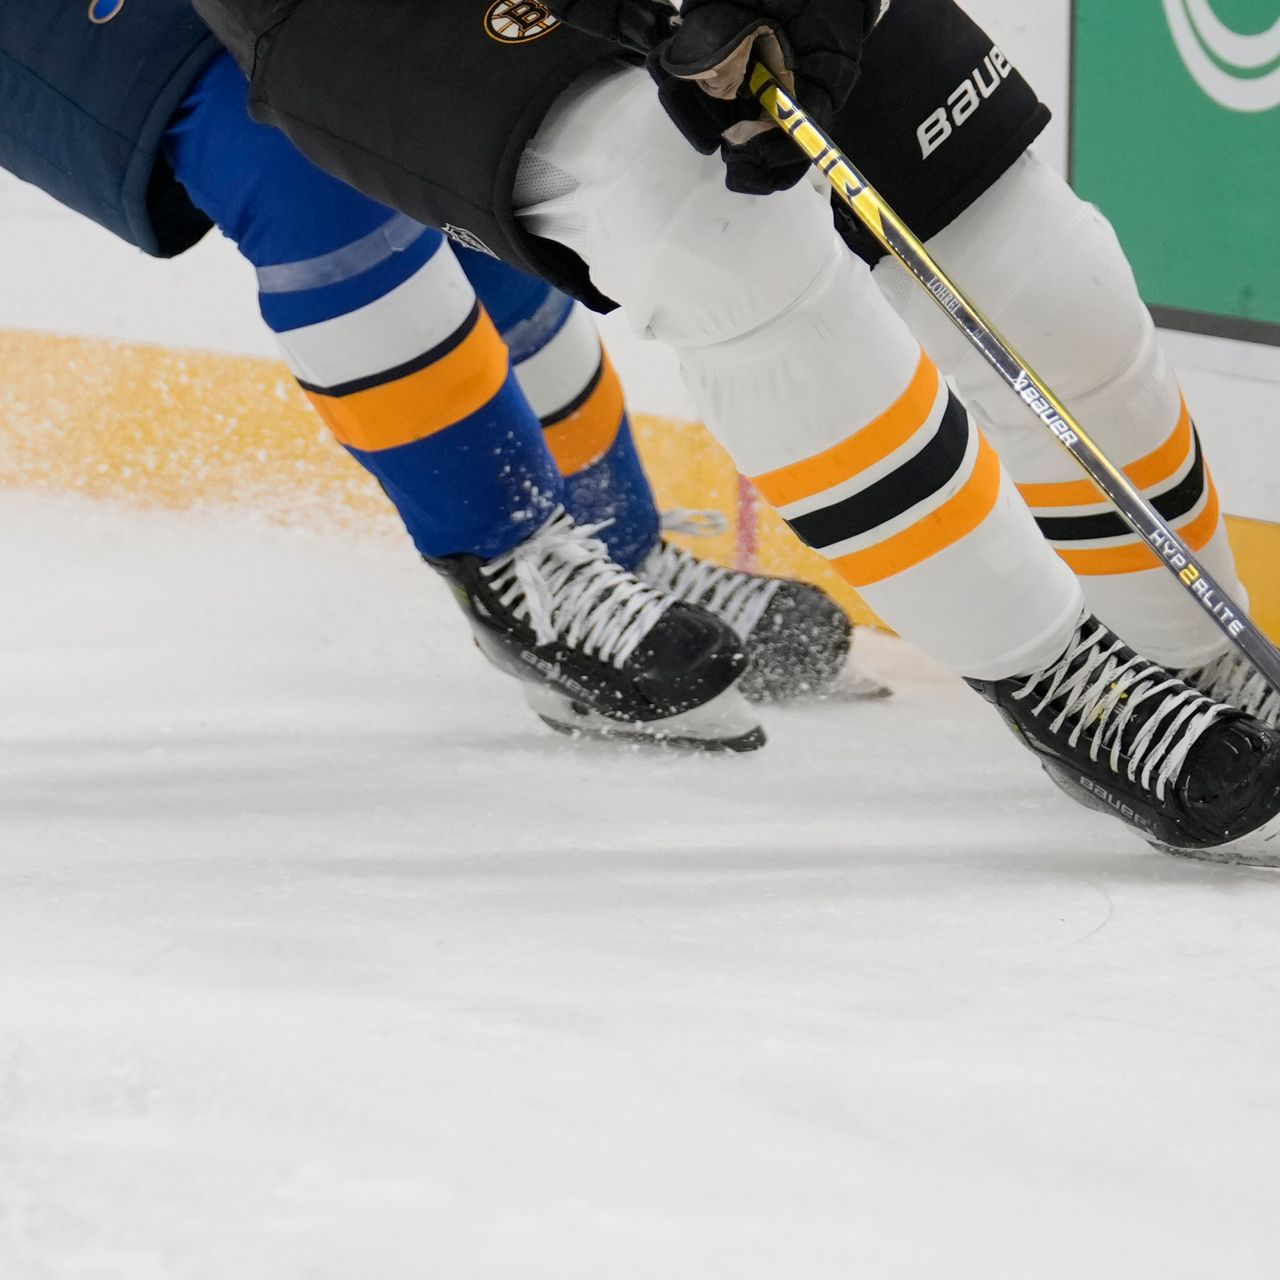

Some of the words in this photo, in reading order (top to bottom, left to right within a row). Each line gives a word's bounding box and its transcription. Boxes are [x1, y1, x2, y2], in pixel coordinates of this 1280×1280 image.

[916, 44, 1013, 160] BAUE
[926, 276, 961, 314] LOHREI
[1149, 529, 1246, 637] HYP2RLITE
